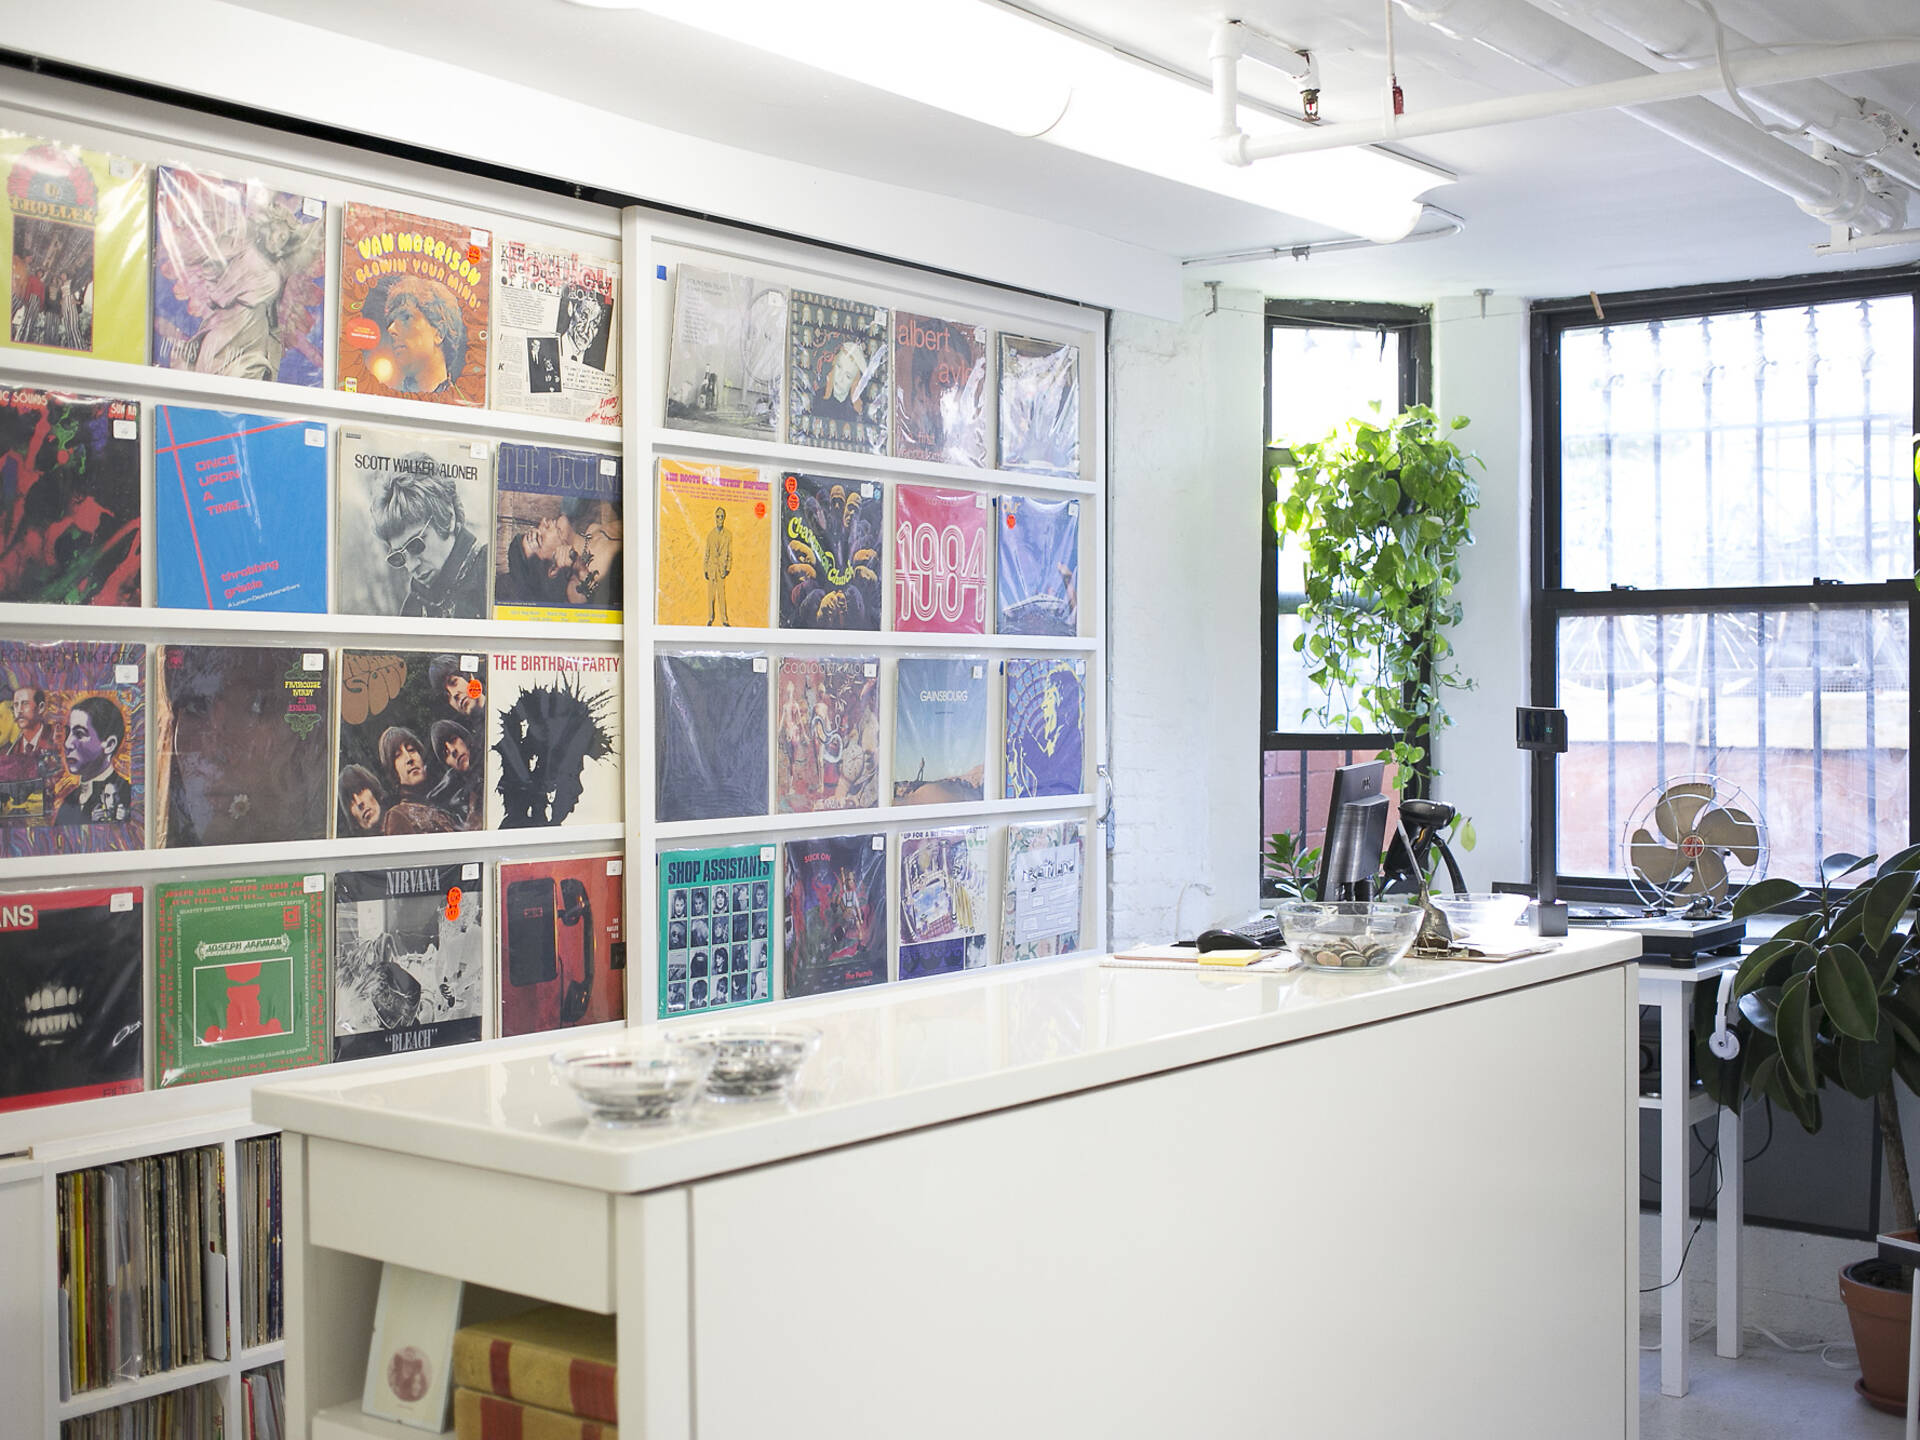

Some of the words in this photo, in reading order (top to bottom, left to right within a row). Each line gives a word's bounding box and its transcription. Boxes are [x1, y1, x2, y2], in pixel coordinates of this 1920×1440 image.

[358, 232, 394, 259] VAN
[397, 231, 481, 286] MORRISON
[412, 259, 445, 281] YOUR
[897, 319, 950, 353] albert
[13, 391, 48, 406] SOUNDS
[195, 454, 238, 471] ONCE
[355, 454, 390, 471] SCOTT
[393, 458, 435, 476] WALKER
[501, 446, 540, 486] THE
[199, 470, 240, 486] UPON
[203, 491, 214, 501] A
[896, 521, 988, 623] 1984
[493, 655, 516, 671] THE
[521, 655, 578, 672] BIRTHDAY
[582, 657, 620, 673] PARTY
[919, 690, 969, 703] GAINSBOURG
[668, 860, 701, 885] SHOP
[703, 855, 770, 882] ASSISTANTS
[385, 868, 440, 896] NIRVANA
[0, 904, 35, 928] NS
